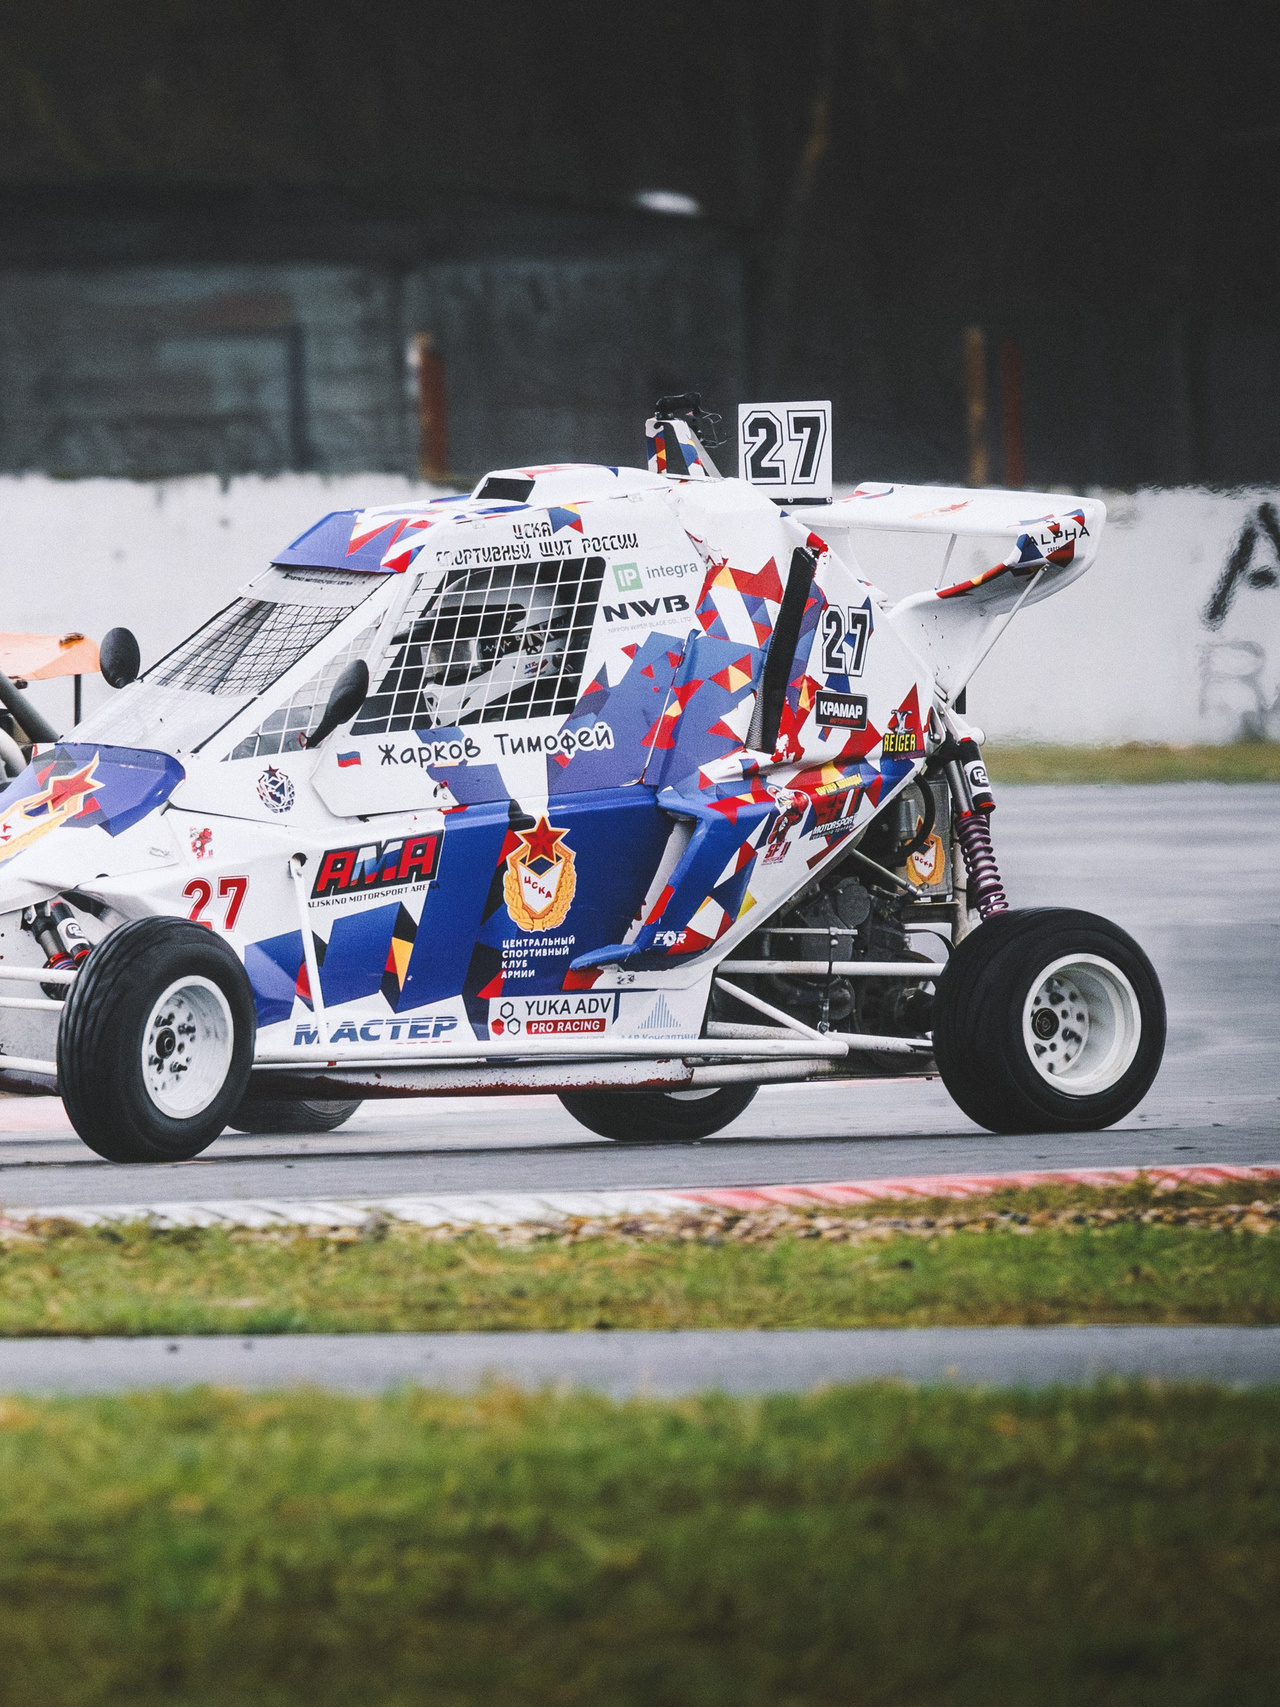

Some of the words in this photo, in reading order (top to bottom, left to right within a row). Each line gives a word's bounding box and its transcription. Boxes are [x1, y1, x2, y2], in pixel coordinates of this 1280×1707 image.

[742, 409, 827, 486] 27
[513, 521, 553, 540] ЦСКА
[1025, 526, 1091, 547] ALPHA
[581, 532, 640, 554] РОССИИ
[617, 567, 638, 588] IP
[646, 561, 699, 580] integra
[602, 594, 691, 623] NWB
[822, 603, 870, 678] 27
[820, 700, 863, 719] КРАМАР
[378, 737, 481, 768] Жарков
[494, 725, 613, 756] Тимофей
[883, 733, 917, 752] REIGER
[813, 815, 855, 835] MOTORSPOR
[316, 835, 438, 892] AMA
[349, 886, 409, 903] MOTORSPORT
[524, 876, 552, 899] ЦСКА
[182, 875, 250, 932] 27
[502, 935, 576, 949] ЦЕНТРАЛЬНЫЙ
[501, 946, 570, 959] СПОРТИВНЫЙ
[500, 969, 536, 979] АРМИИ
[501, 959, 528, 969] КЛУБ
[525, 999, 571, 1016] YUKA
[575, 997, 612, 1014] ADV
[293, 1015, 459, 1046] МАСТЕР
[531, 1022, 554, 1034] PRO
[557, 1020, 601, 1032] RACING
